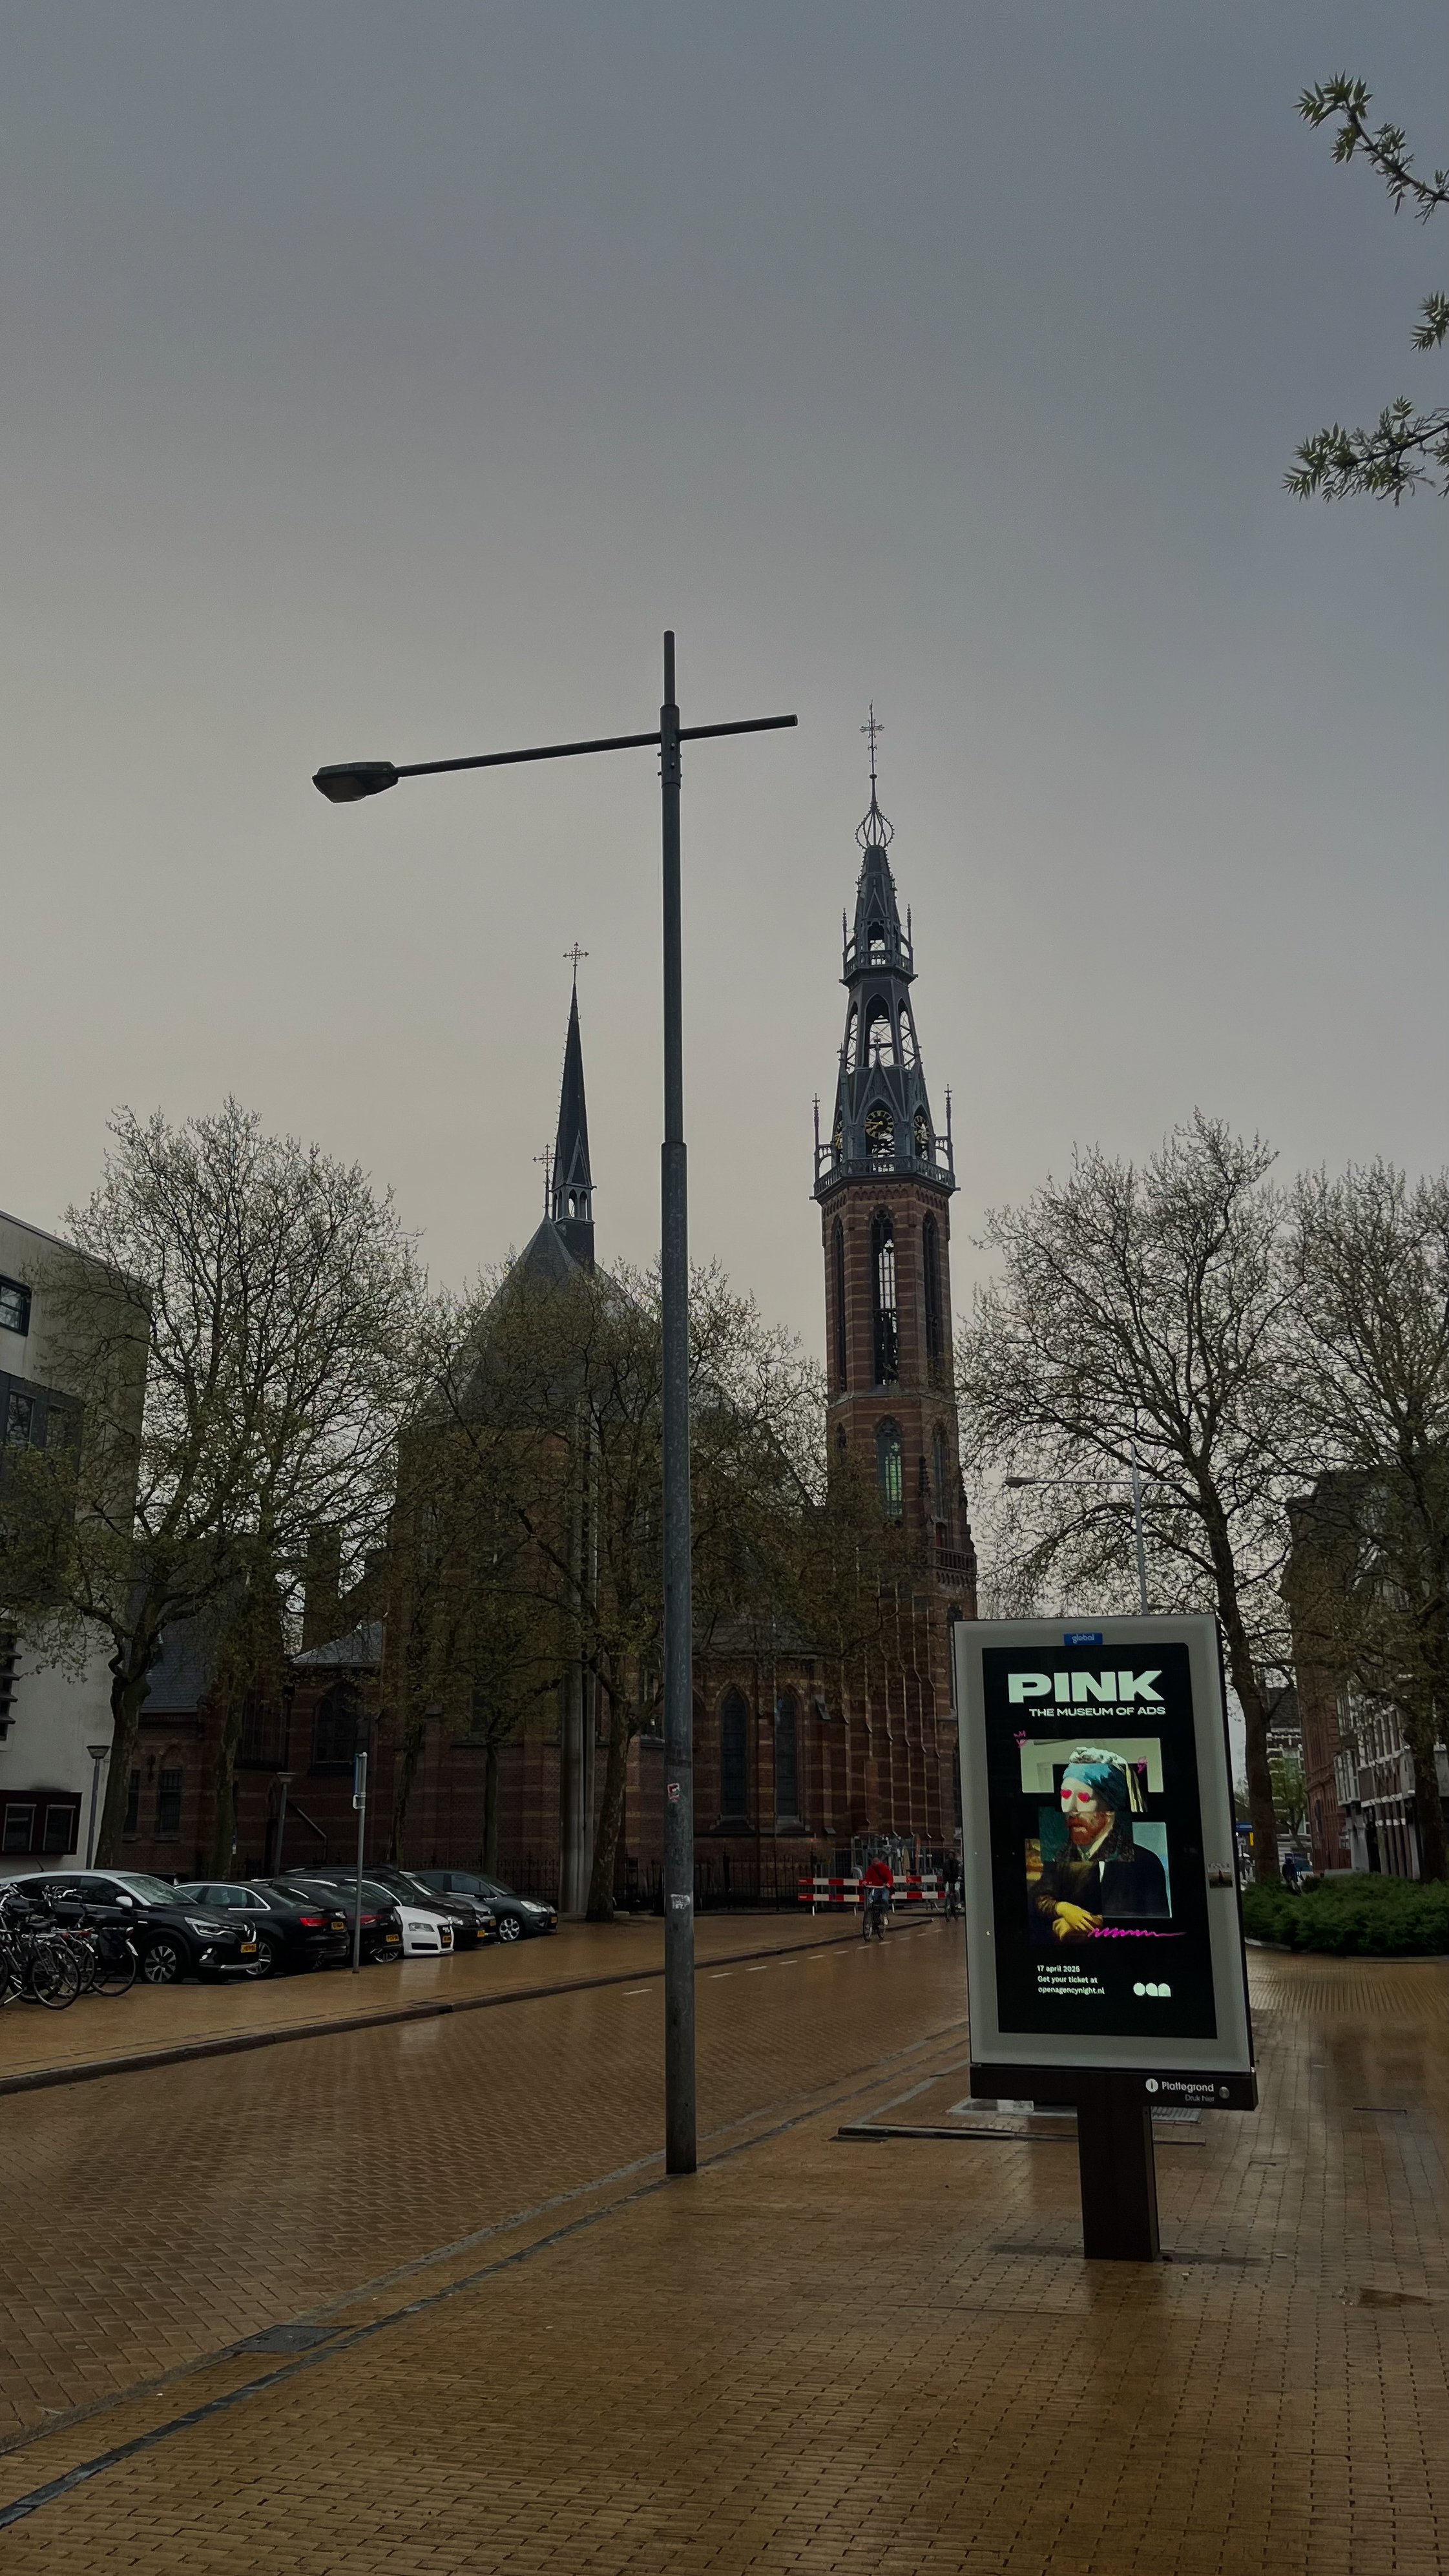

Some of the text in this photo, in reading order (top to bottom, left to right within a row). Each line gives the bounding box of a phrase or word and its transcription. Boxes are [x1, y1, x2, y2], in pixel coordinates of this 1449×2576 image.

[1072, 1633, 1094, 1644] global
[1008, 1670, 1165, 1703] PINK
[1029, 1706, 1166, 1717] THE MUSEUM OF ADS
[1046, 1965, 1062, 1973] april
[1037, 1986, 1105, 1996] openagencynight.nl
[1162, 2081, 1214, 2093] Plattegrond
